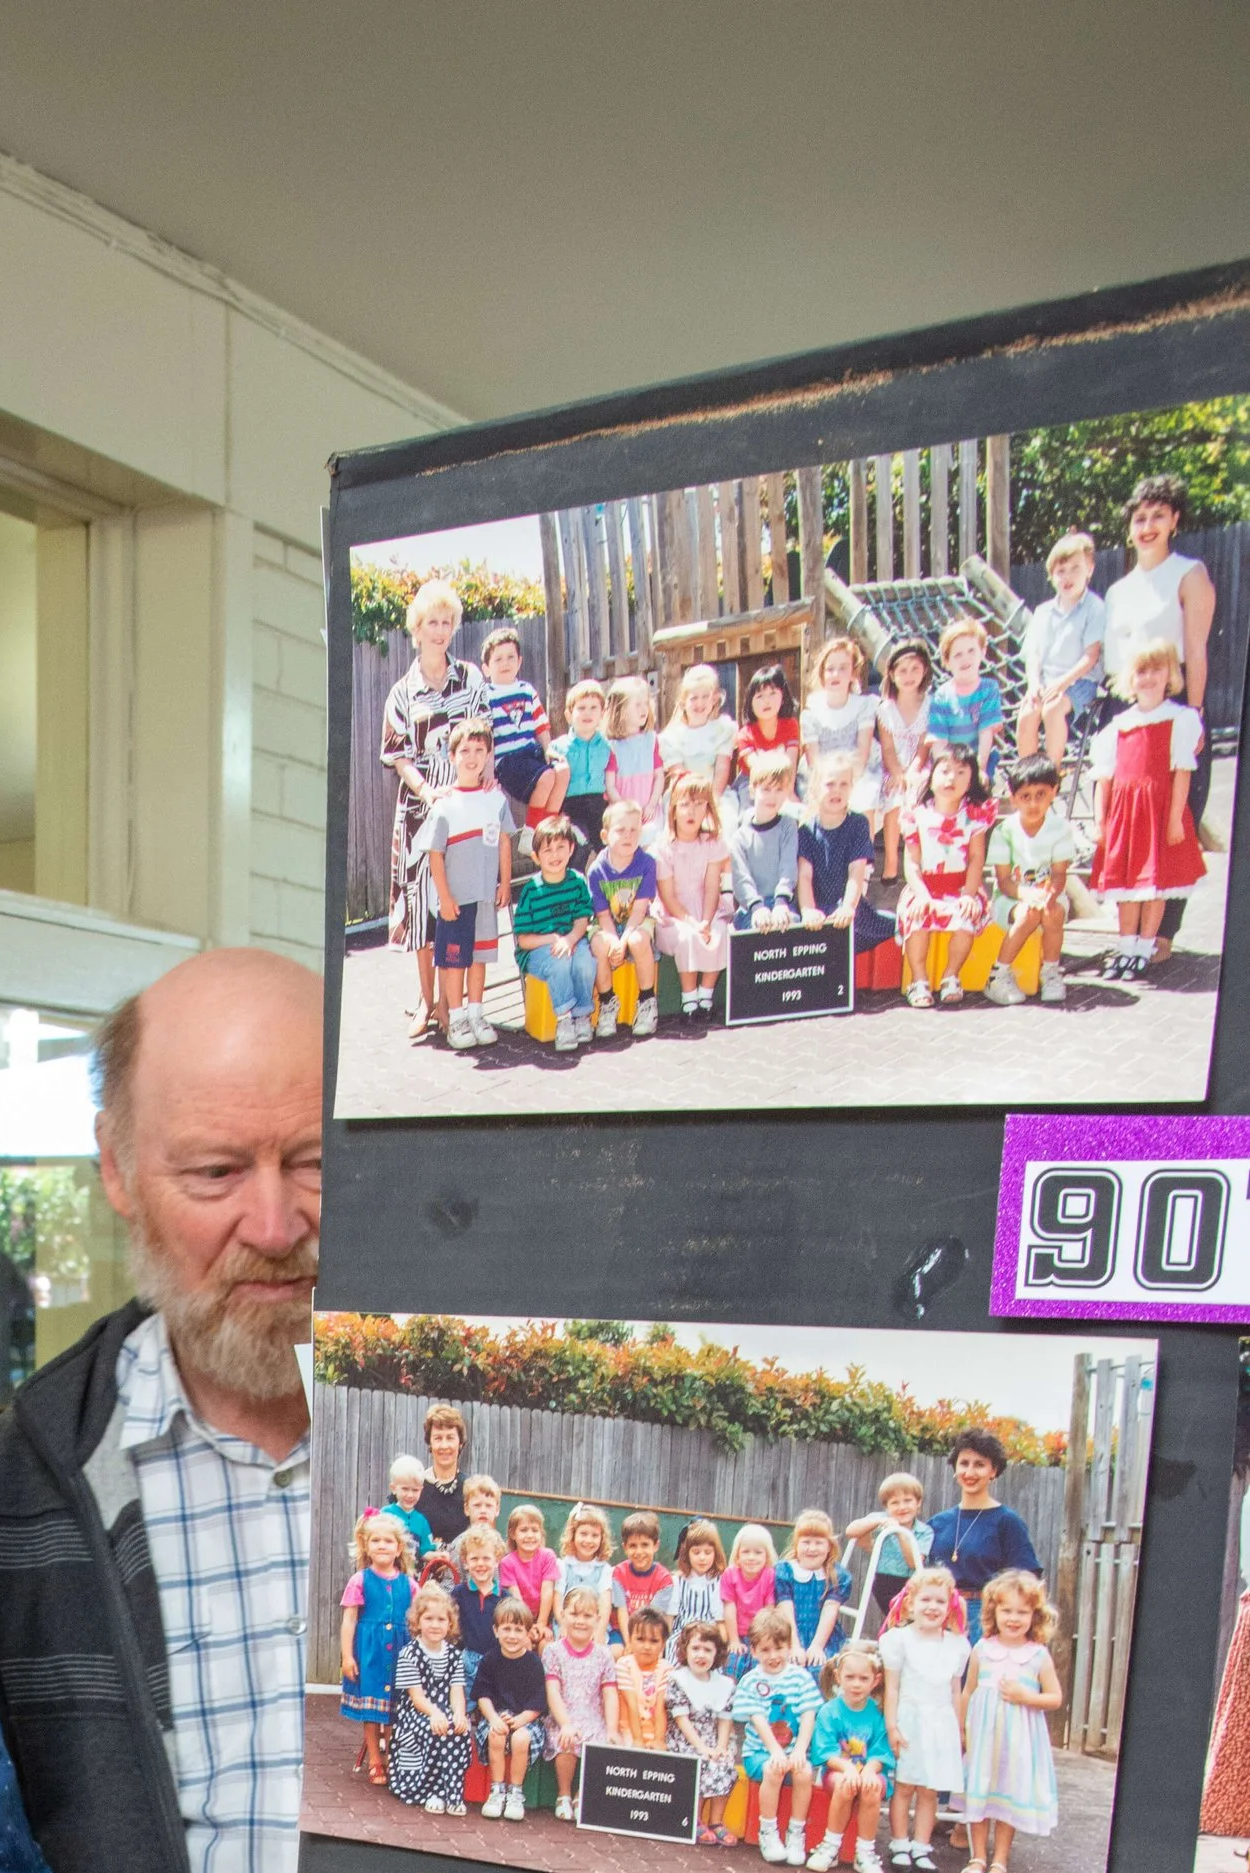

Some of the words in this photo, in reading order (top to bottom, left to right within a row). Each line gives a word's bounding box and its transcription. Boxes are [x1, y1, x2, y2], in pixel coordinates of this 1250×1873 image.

[753, 947, 787, 962] NORTH
[792, 942, 827, 956] EPPING
[754, 965, 825, 983] KINDERGARTEN
[782, 990, 802, 1002] 1993
[837, 985, 844, 996] 2
[1024, 1167, 1250, 1292] 90
[605, 1765, 638, 1779] NORTH
[642, 1770, 676, 1783] EPPING
[605, 1785, 672, 1804] KINDERGARTEN
[630, 1810, 649, 1822] 1993
[681, 1816, 689, 1827] 6
